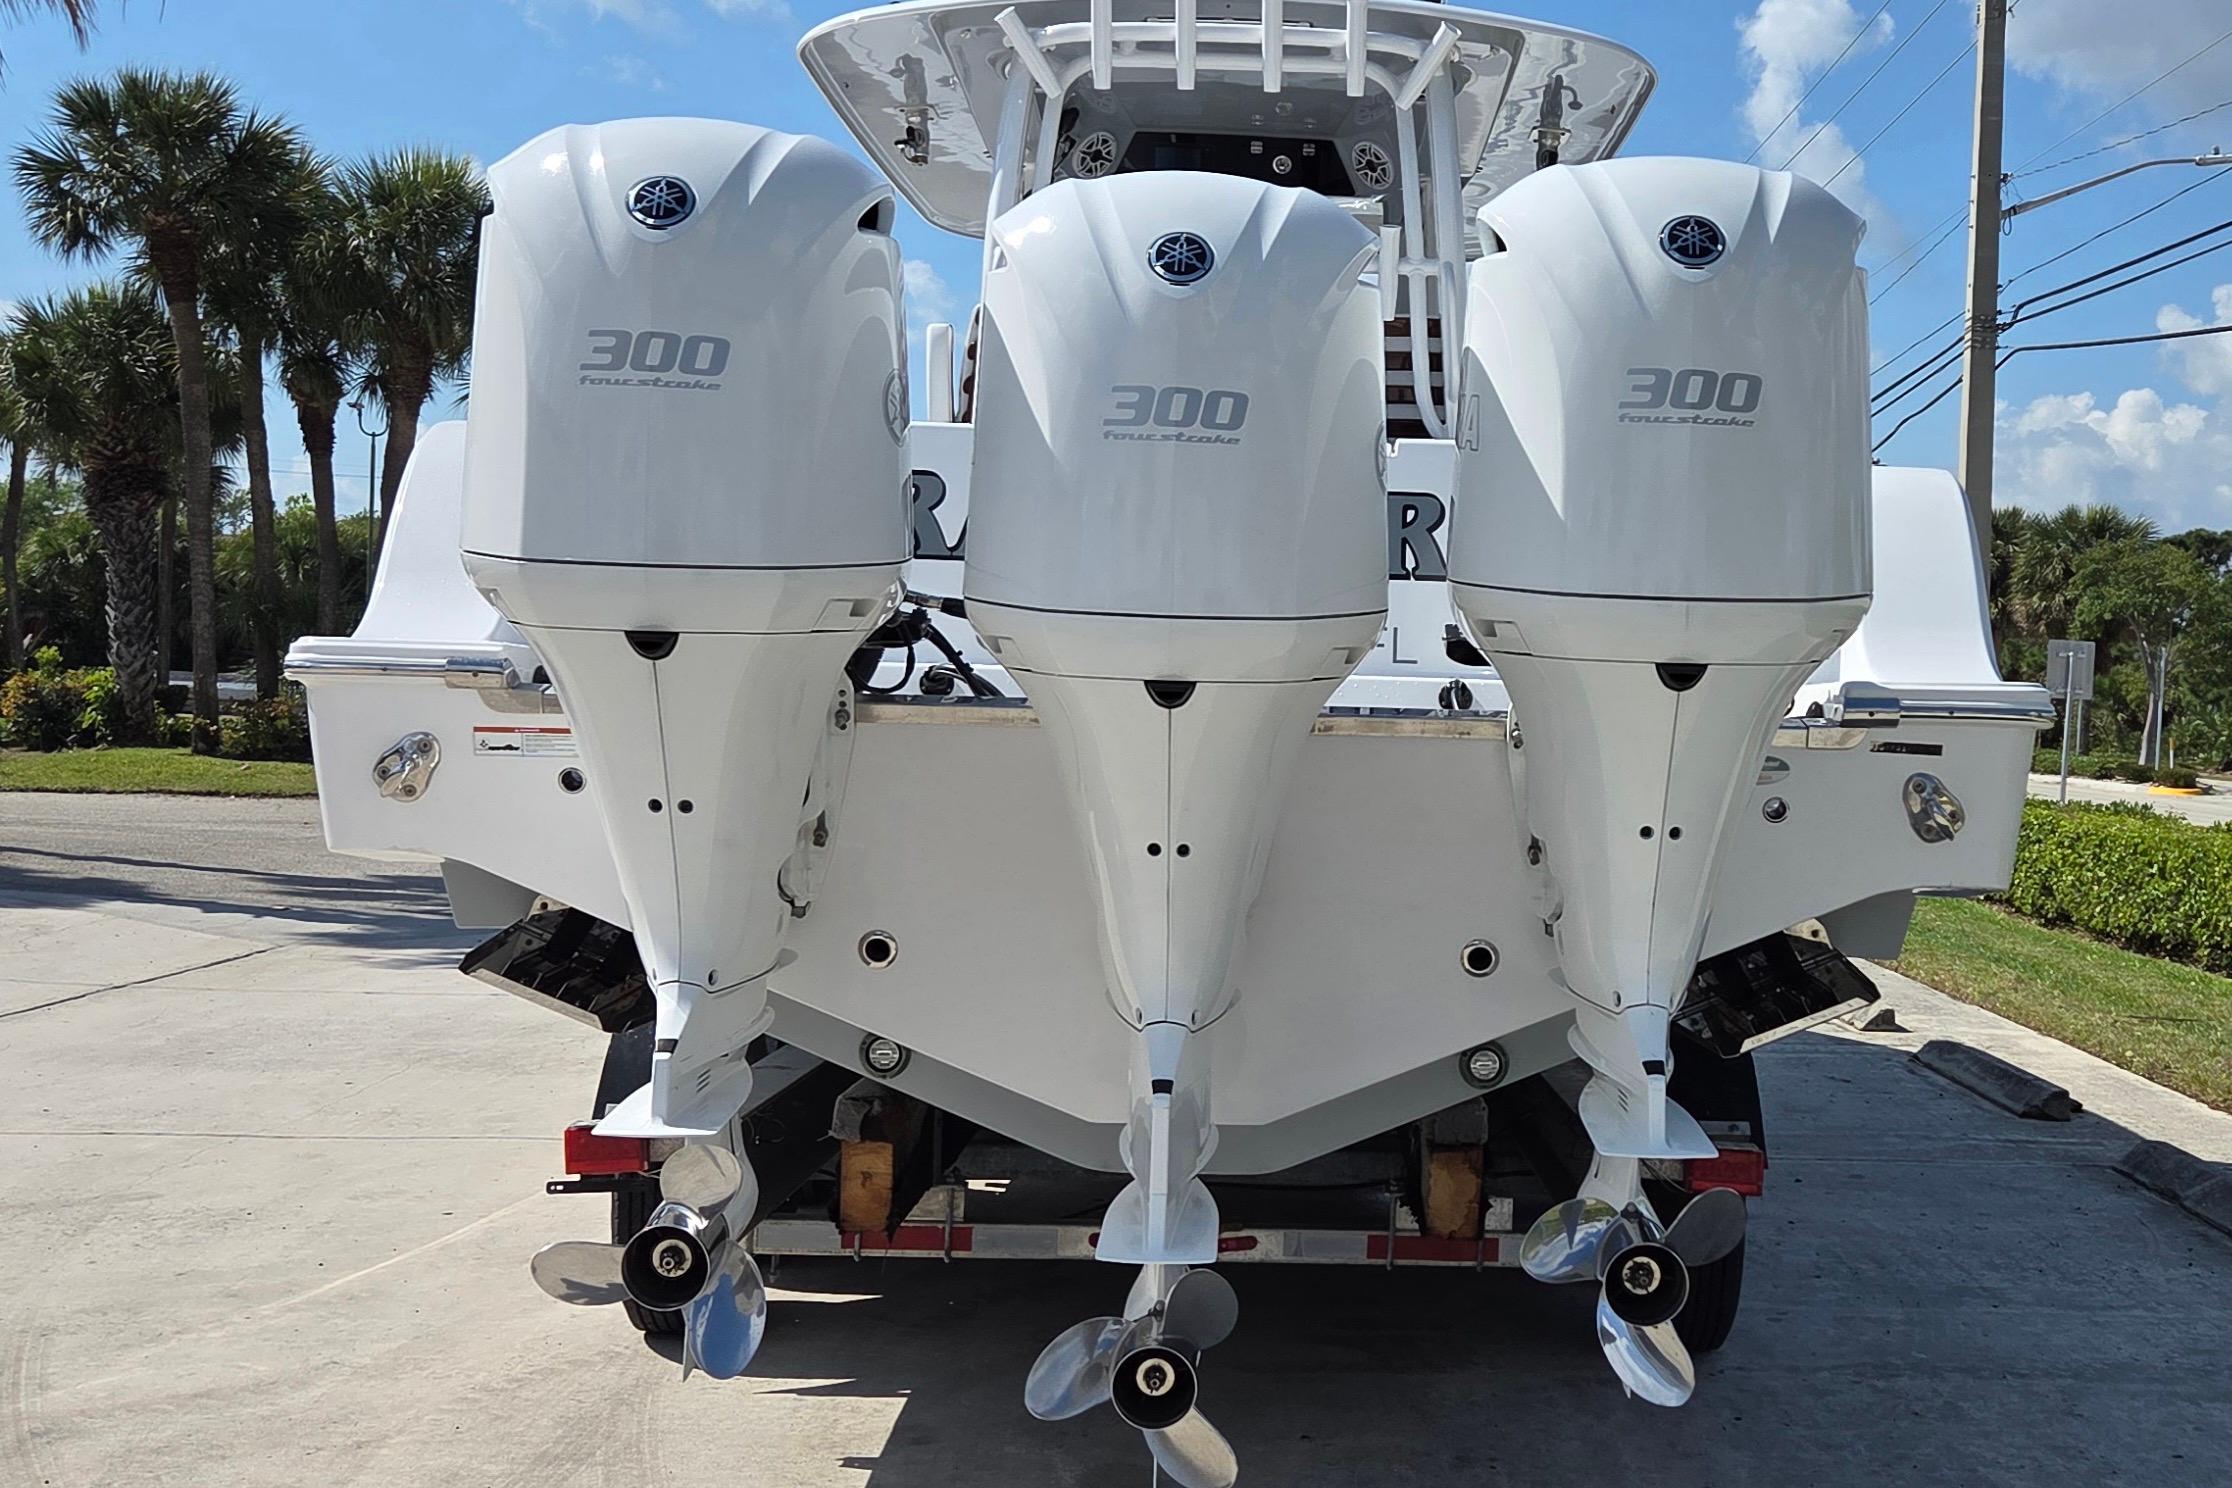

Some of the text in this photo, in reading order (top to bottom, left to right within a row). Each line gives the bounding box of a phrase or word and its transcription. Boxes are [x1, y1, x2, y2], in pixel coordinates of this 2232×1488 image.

[579, 329, 731, 377] 300
[1102, 384, 1250, 431] 300
[1618, 367, 1763, 413] 300
[911, 469, 966, 561] R
